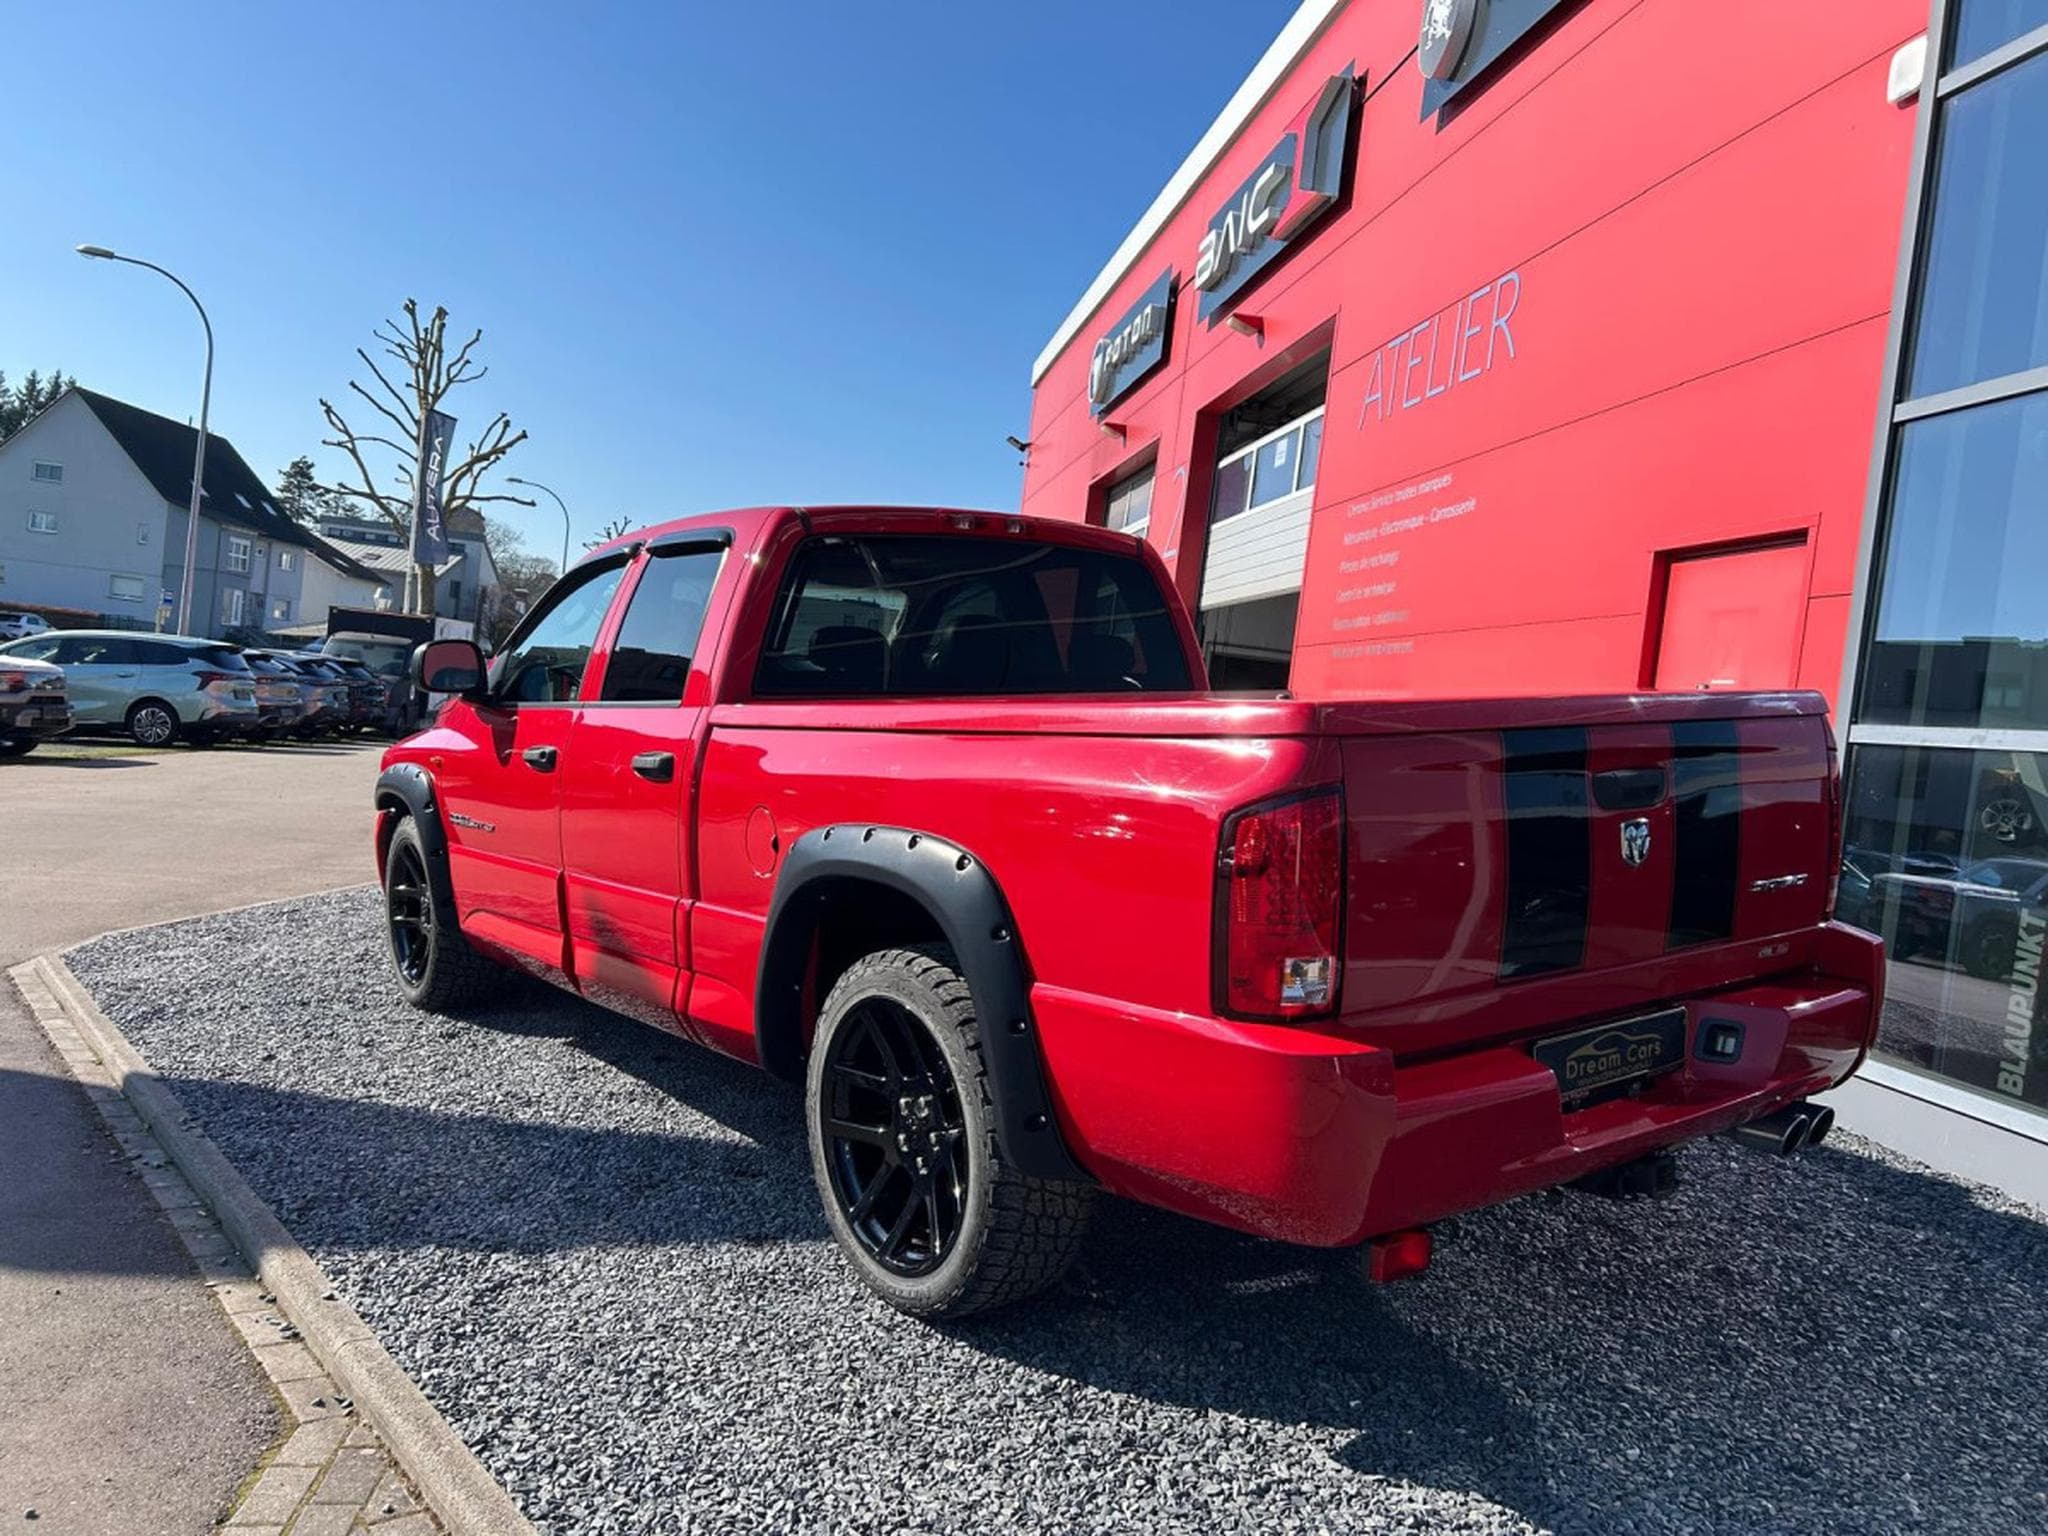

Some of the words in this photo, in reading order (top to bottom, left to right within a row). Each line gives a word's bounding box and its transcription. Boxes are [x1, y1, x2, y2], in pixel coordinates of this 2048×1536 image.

[1359, 271, 1520, 431] ATELIER
[426, 437, 443, 541] AUTERA
[1566, 1052, 1621, 1079] Dream
[1627, 1041, 1663, 1063] Cars
[1996, 907, 2047, 1096] BLAUPUNKT
